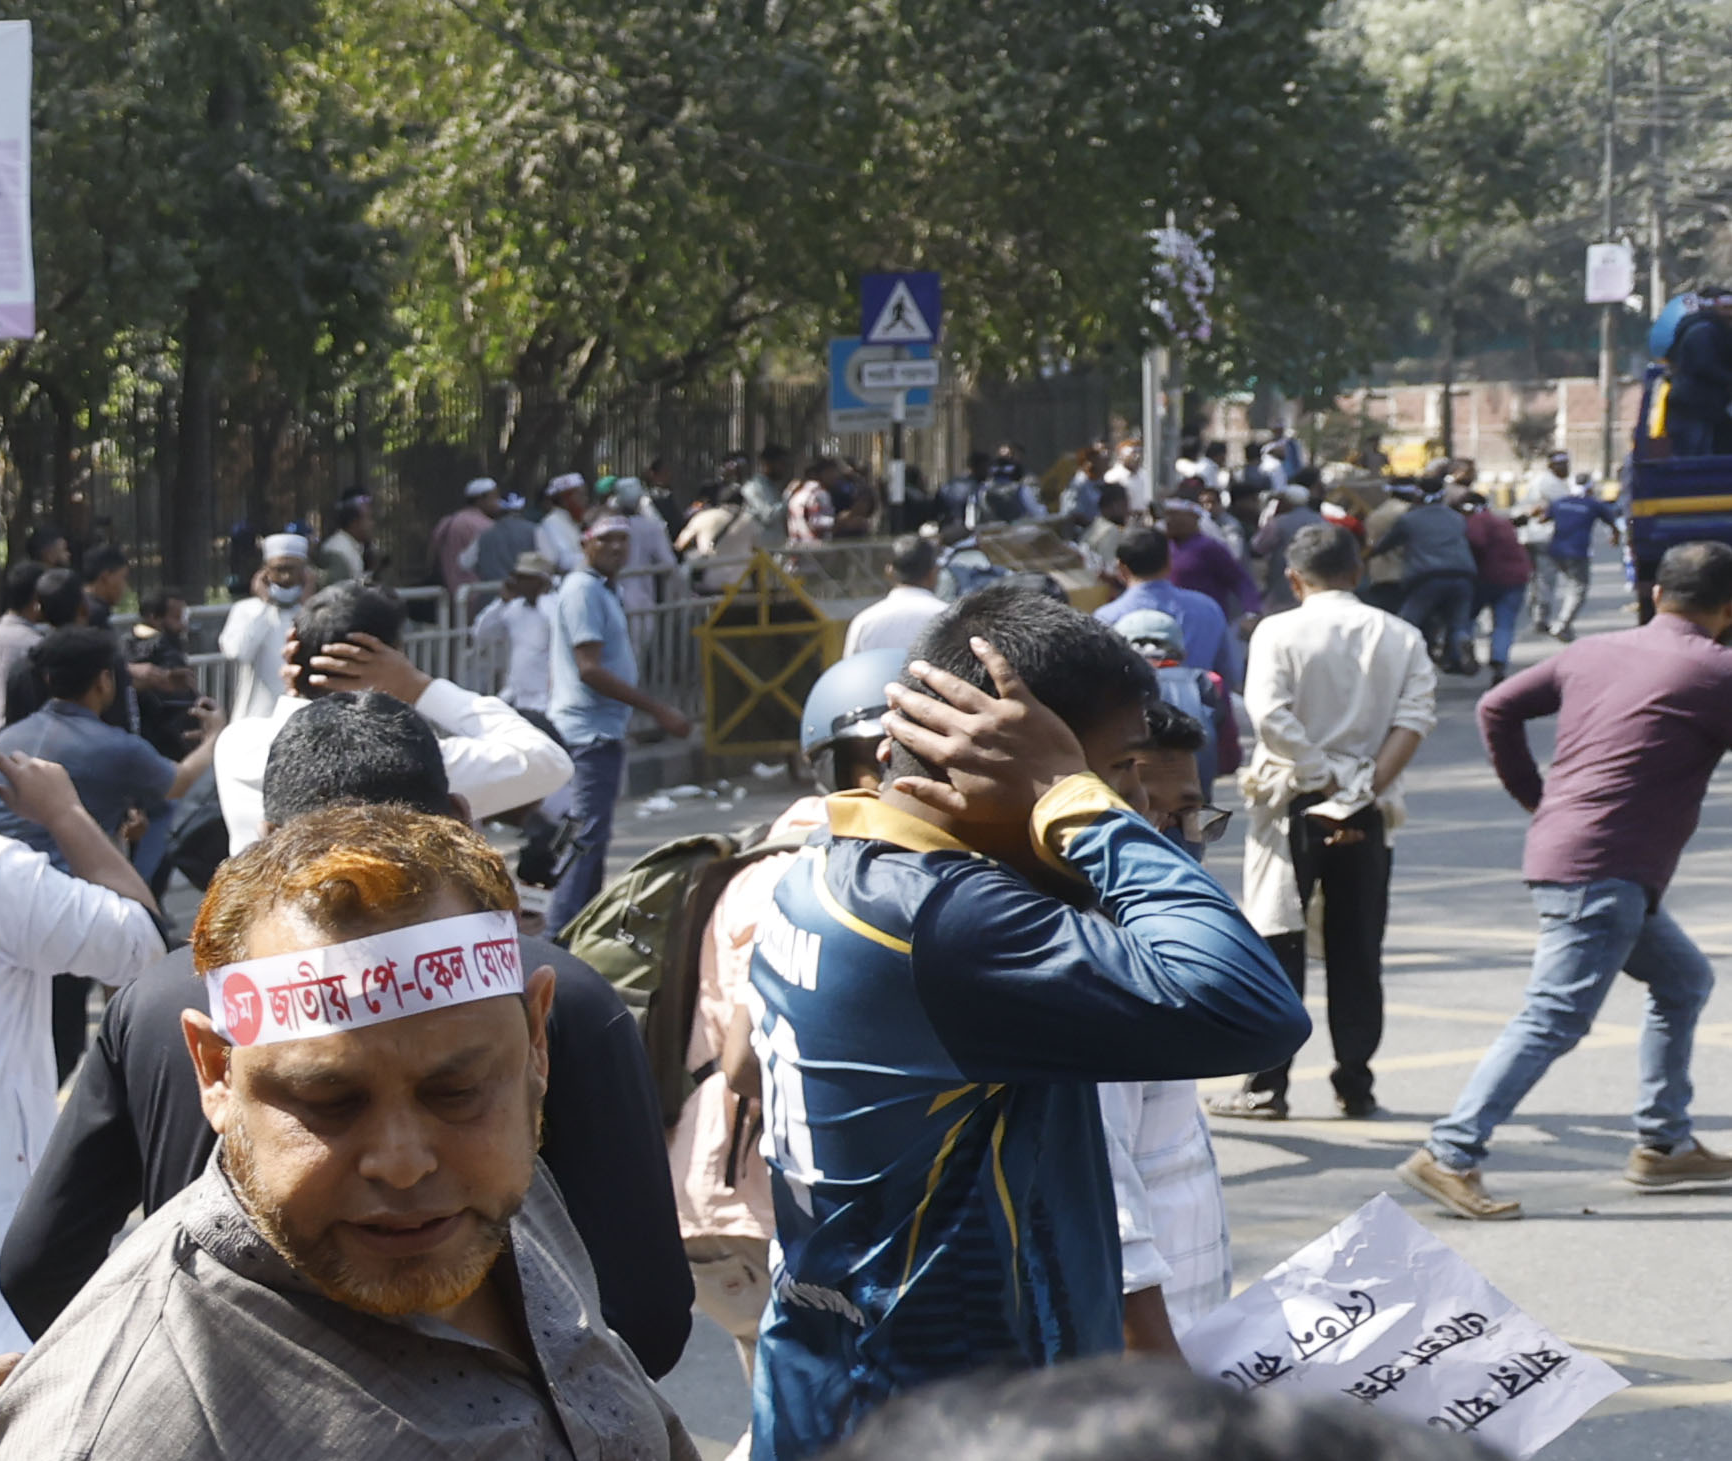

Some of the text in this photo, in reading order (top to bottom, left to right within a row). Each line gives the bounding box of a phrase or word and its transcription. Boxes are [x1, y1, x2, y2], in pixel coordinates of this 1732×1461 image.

[224, 992, 255, 1029] ৯ম
[266, 960, 352, 1031] জাতীয়
[361, 946, 475, 1014] পে-স্কেল
[1287, 1290, 1377, 1361] বেতন
